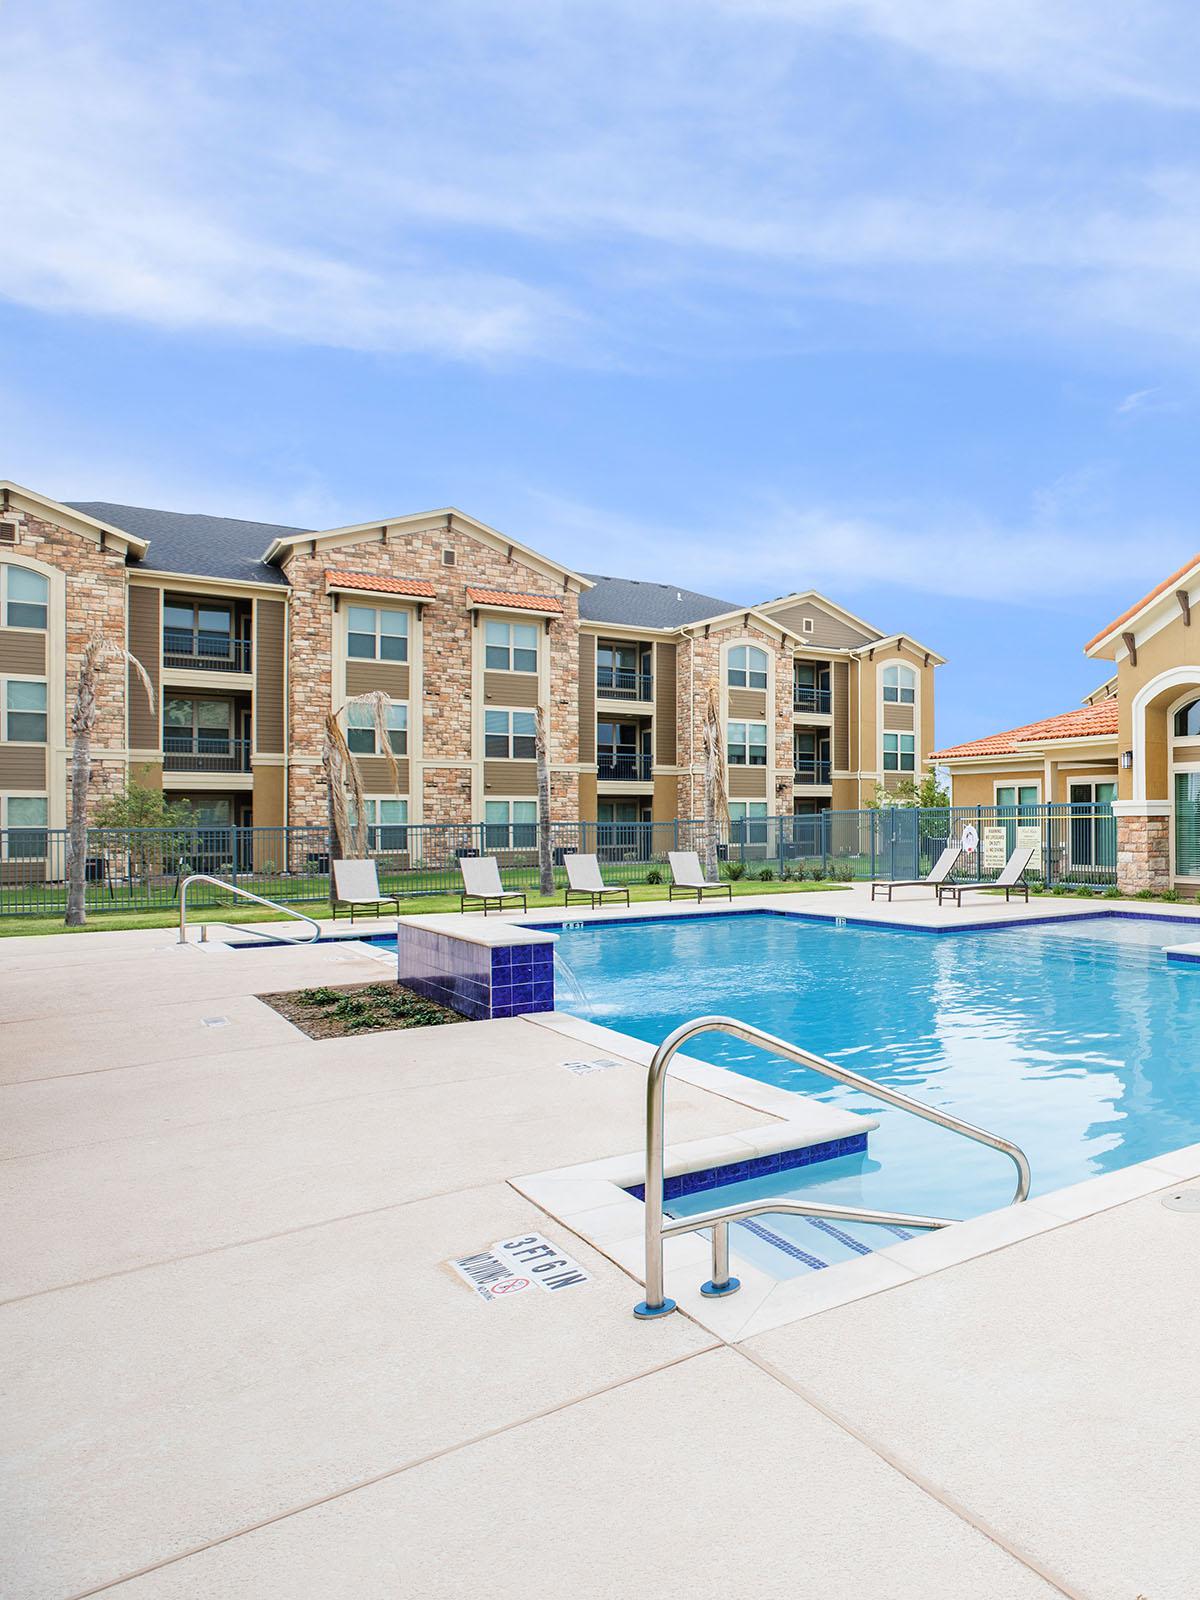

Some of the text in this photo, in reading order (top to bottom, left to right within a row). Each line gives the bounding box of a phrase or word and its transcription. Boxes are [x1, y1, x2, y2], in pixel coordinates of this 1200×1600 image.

[455, 1251, 514, 1285] NO DIVING
[503, 1237, 588, 1290] 3 FT 6 IN
